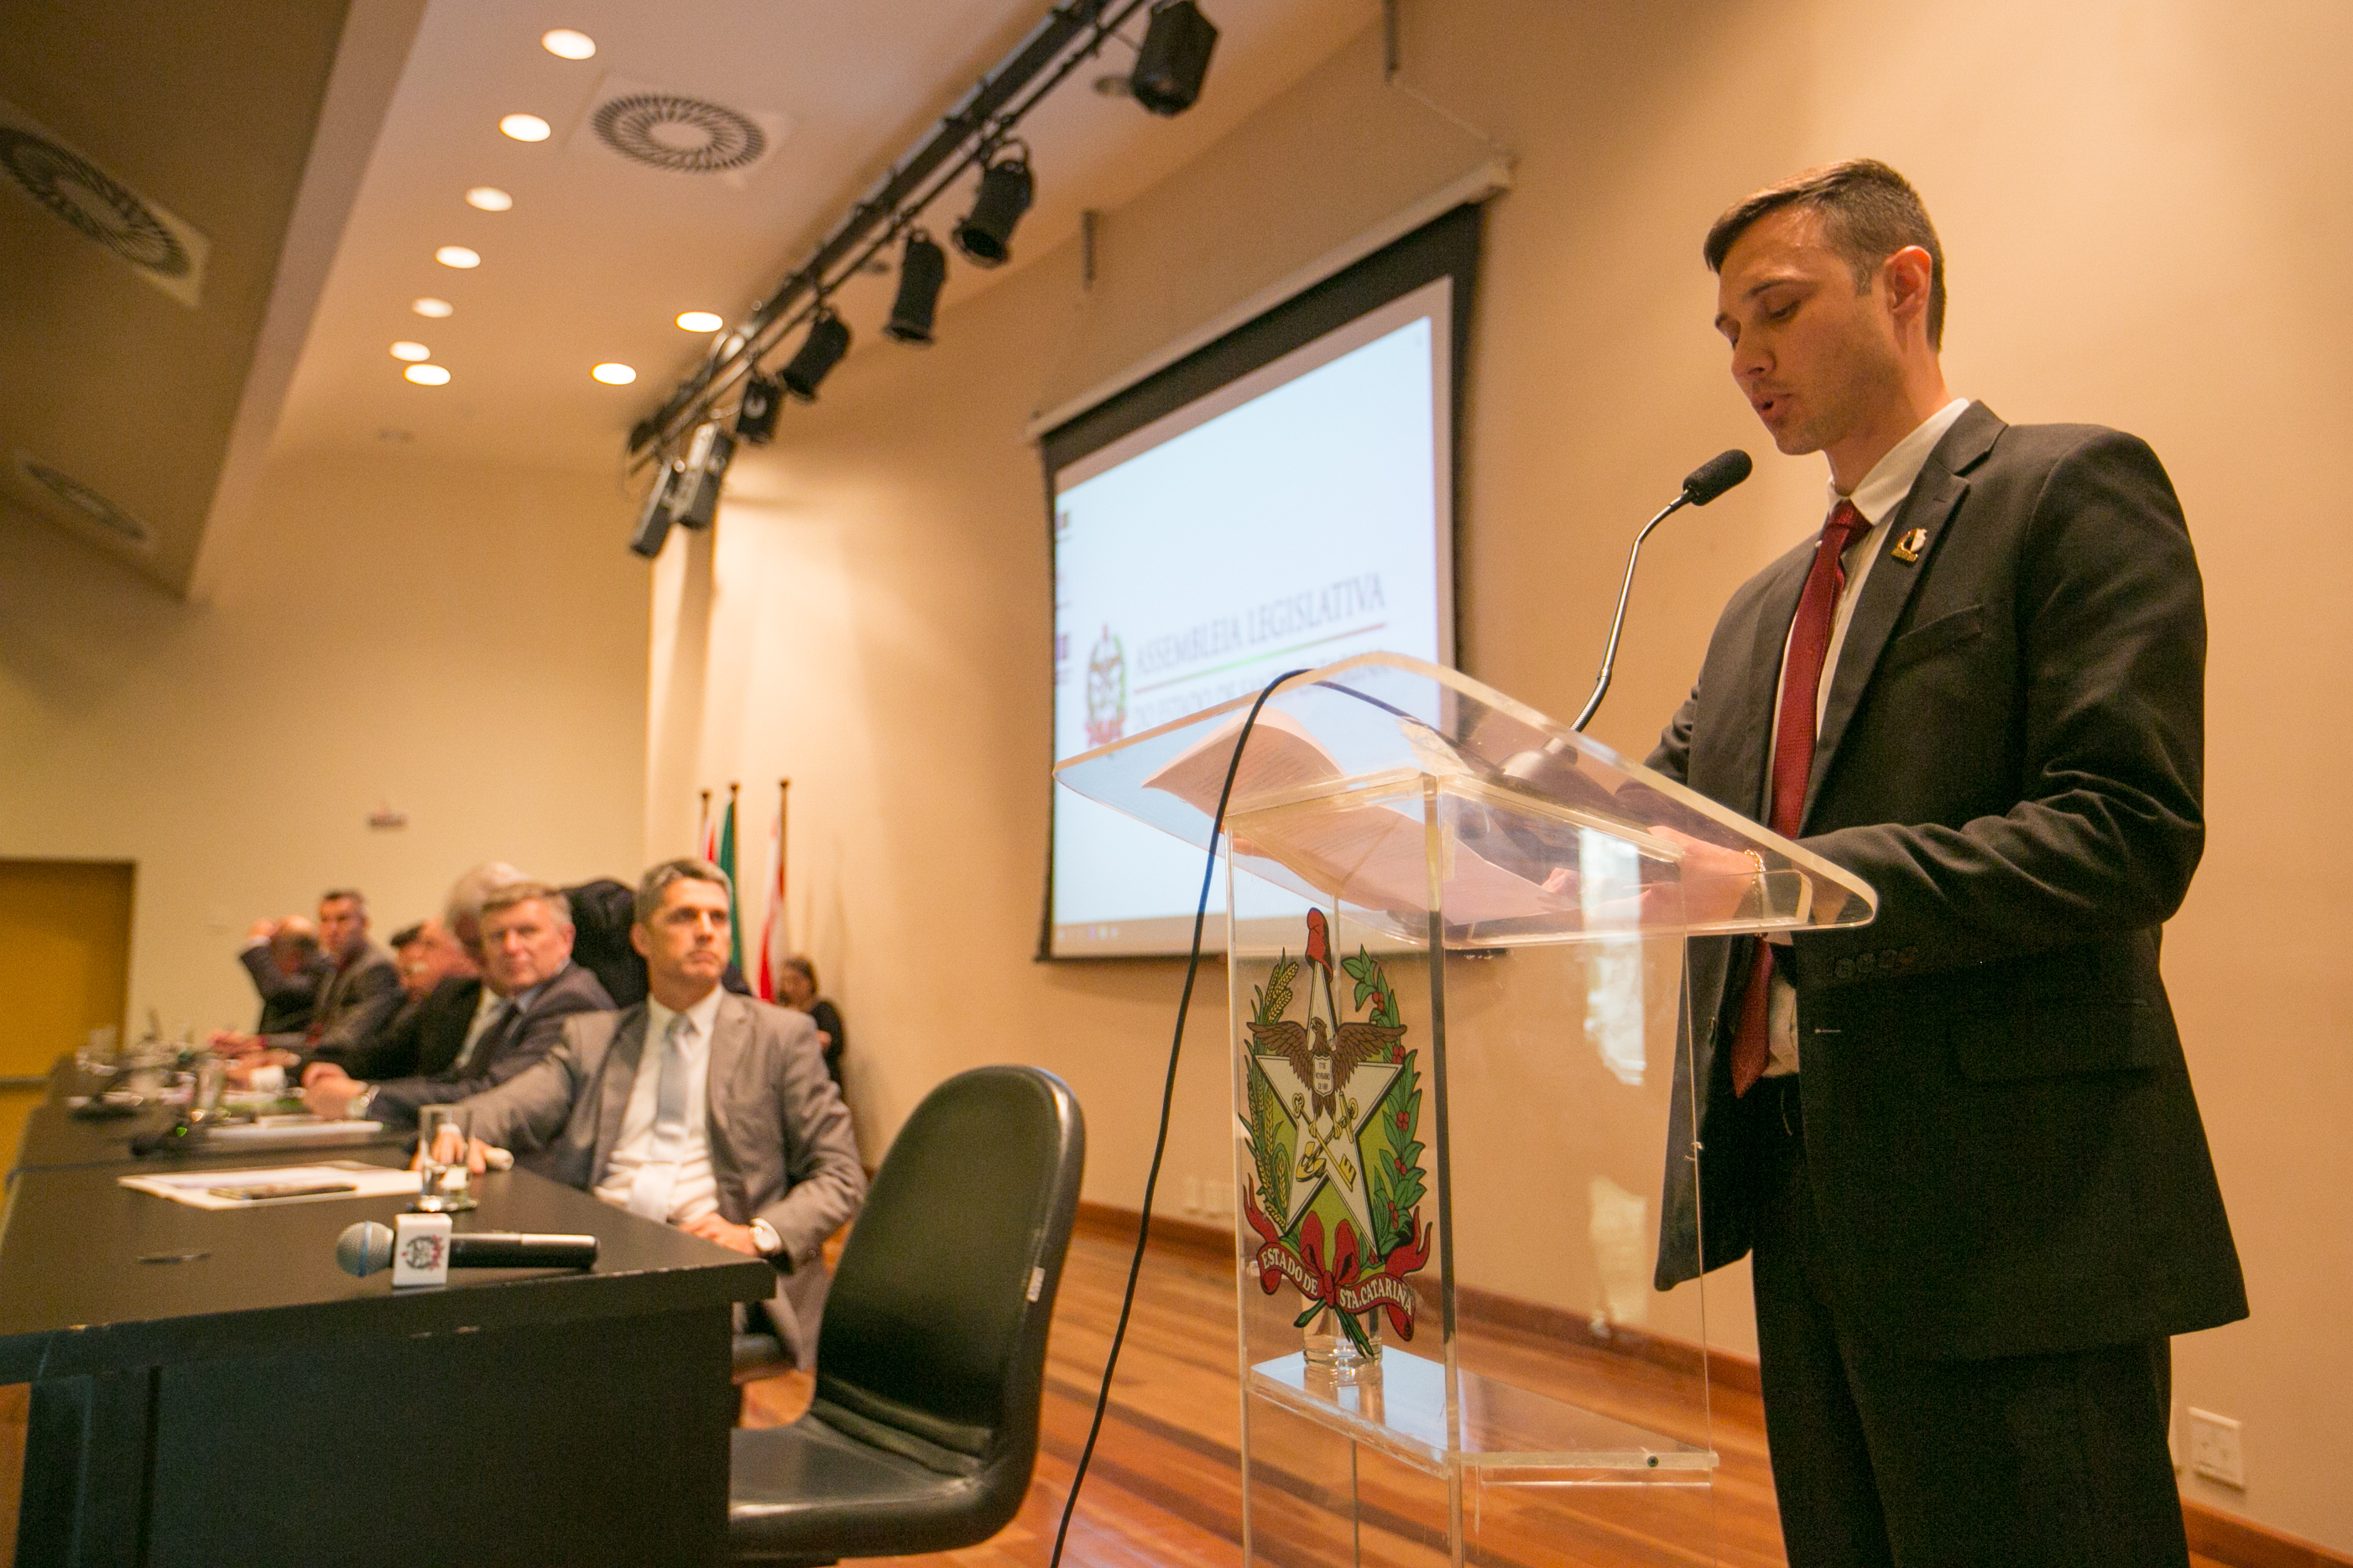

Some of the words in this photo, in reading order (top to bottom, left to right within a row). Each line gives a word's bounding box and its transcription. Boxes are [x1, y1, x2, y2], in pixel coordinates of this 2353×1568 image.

[1248, 571, 1386, 644] LEGISLATIVA
[1260, 1247, 1303, 1283] ESTADO
[1302, 1273, 1318, 1296] DE
